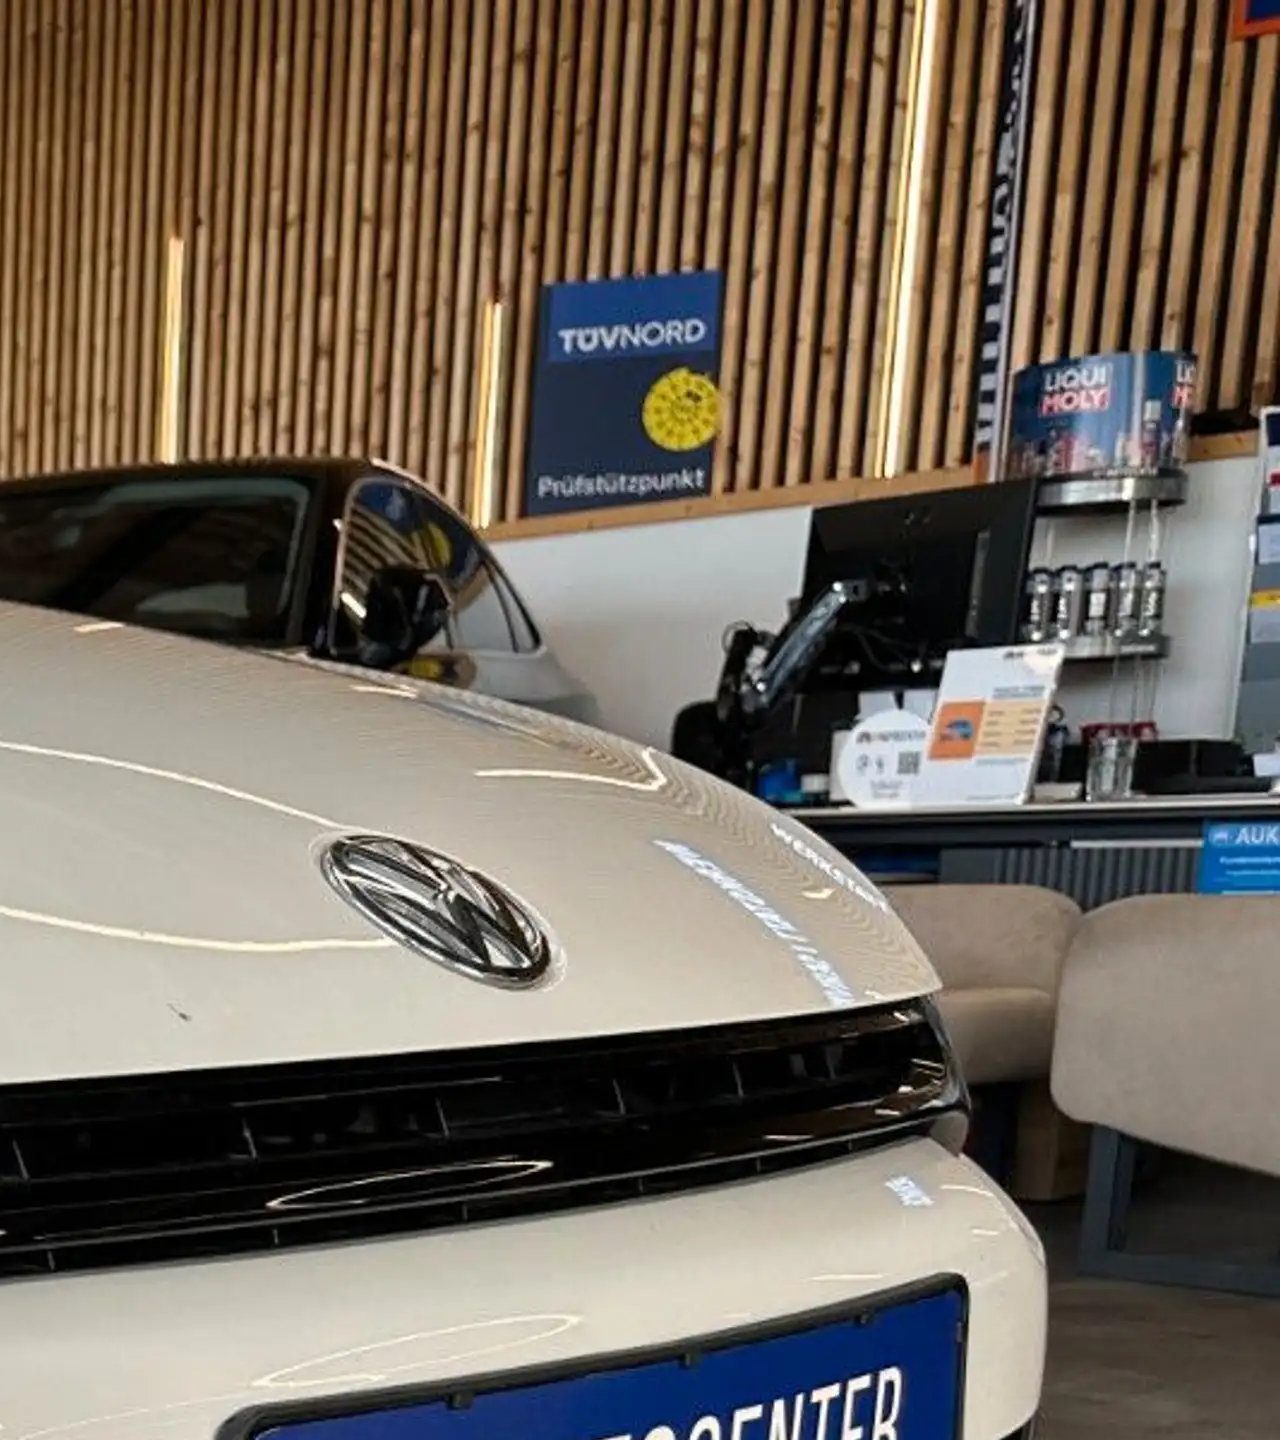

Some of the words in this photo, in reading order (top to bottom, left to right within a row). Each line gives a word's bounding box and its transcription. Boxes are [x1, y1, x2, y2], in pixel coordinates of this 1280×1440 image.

[1044, 366, 1107, 392] LIQUI
[1042, 386, 1110, 416] MOLY
[537, 469, 706, 499] Prüfstützpunkt
